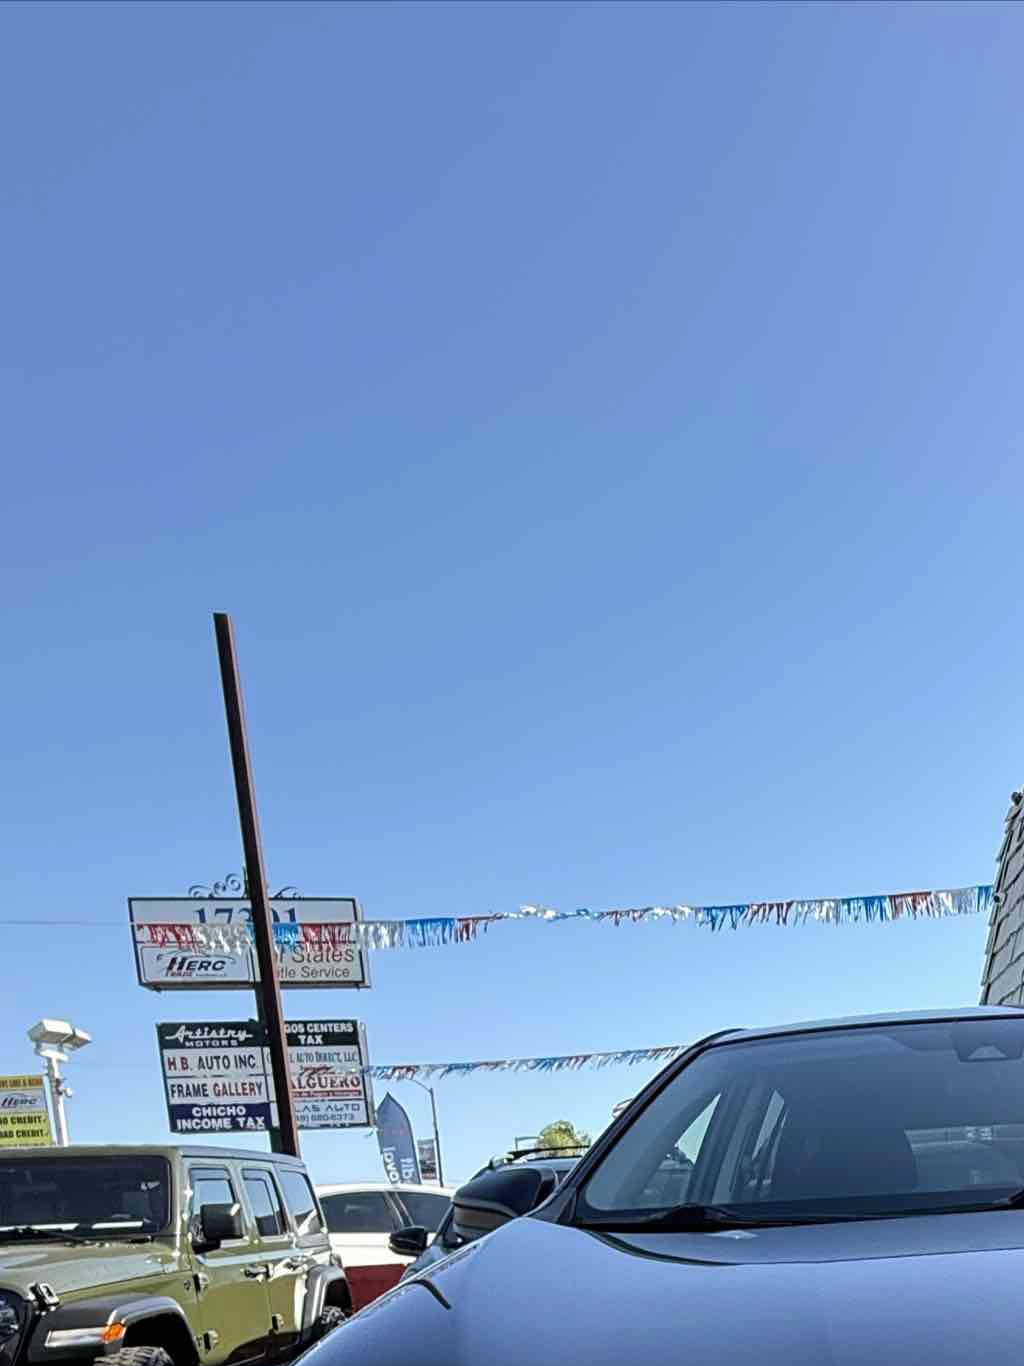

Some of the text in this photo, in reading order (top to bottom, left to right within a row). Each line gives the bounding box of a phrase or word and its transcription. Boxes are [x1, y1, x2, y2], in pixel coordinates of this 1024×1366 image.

[301, 966, 350, 978] Service
[165, 1025, 253, 1042] Artistry
[306, 1022, 354, 1033] CENTERS
[298, 1035, 323, 1045] TAX
[198, 1055, 231, 1071] AUTO
[170, 1082, 262, 1098] FRAME GALLERY
[192, 1106, 246, 1117] CHICHO
[177, 1116, 265, 1131] INCOME TAX
